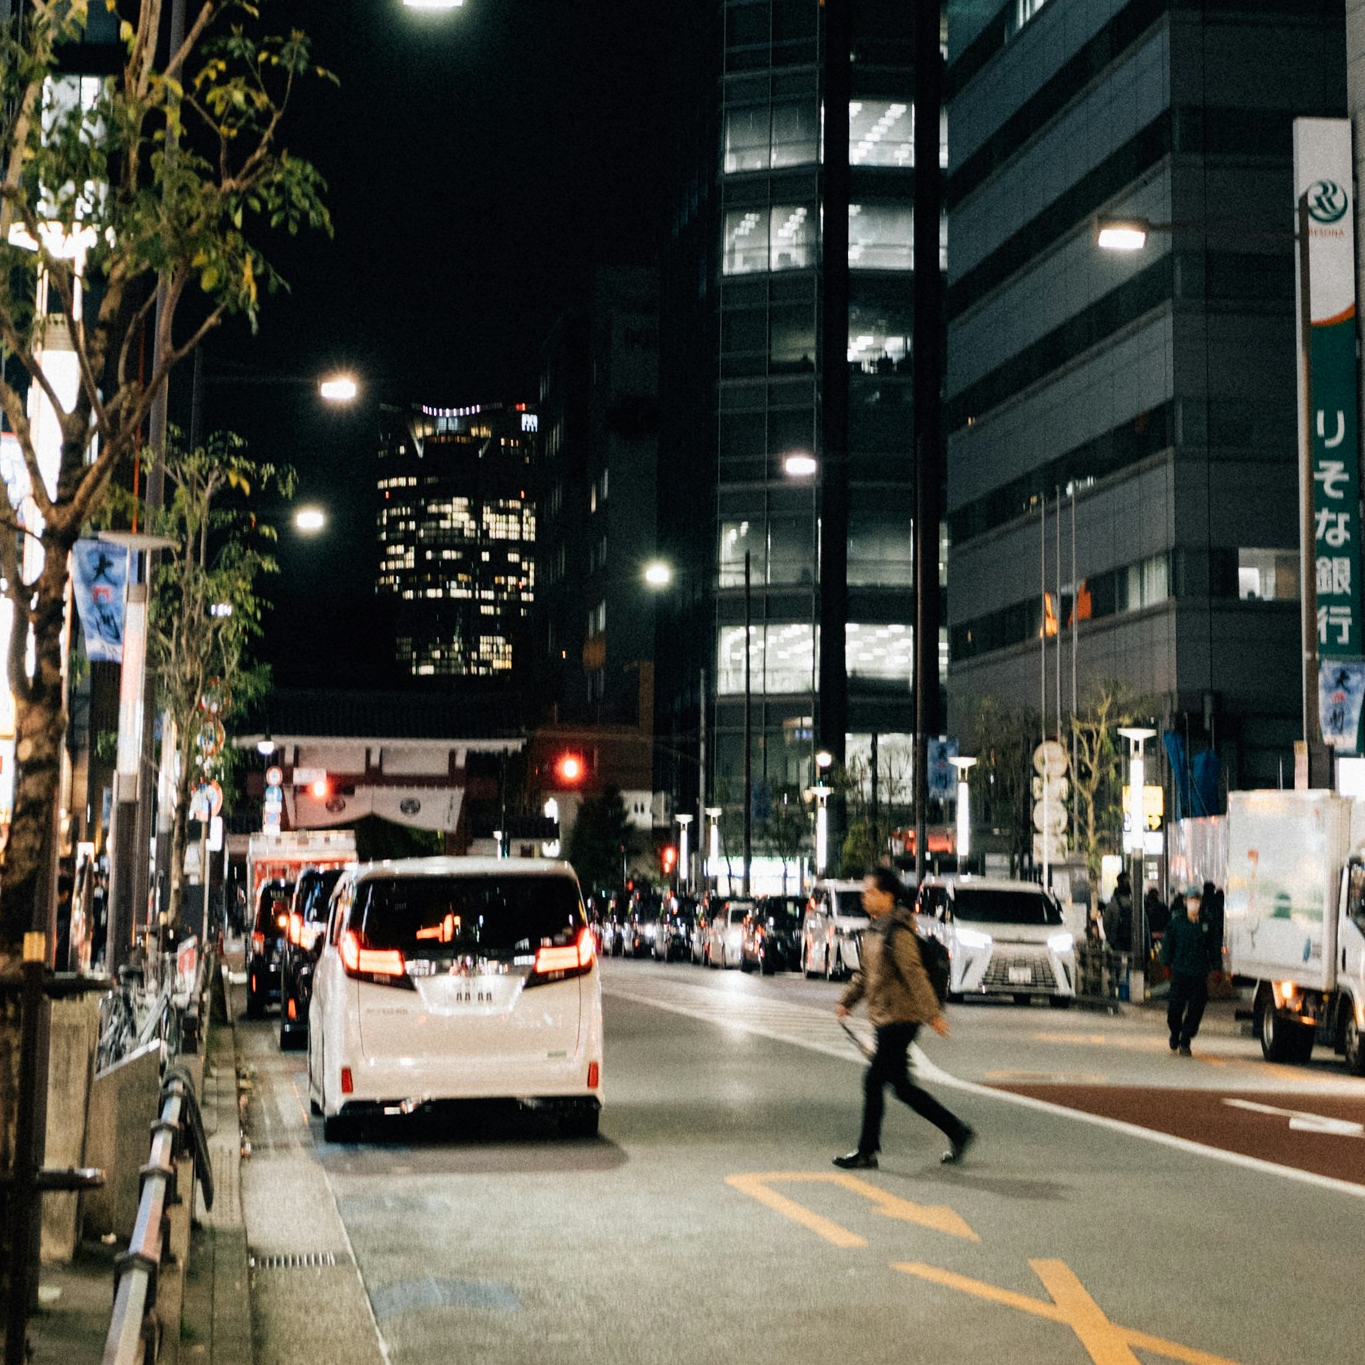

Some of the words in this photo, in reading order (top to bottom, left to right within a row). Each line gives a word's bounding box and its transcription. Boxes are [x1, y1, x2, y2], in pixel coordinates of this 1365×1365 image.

[1314, 409, 1353, 646] りそな銀行
